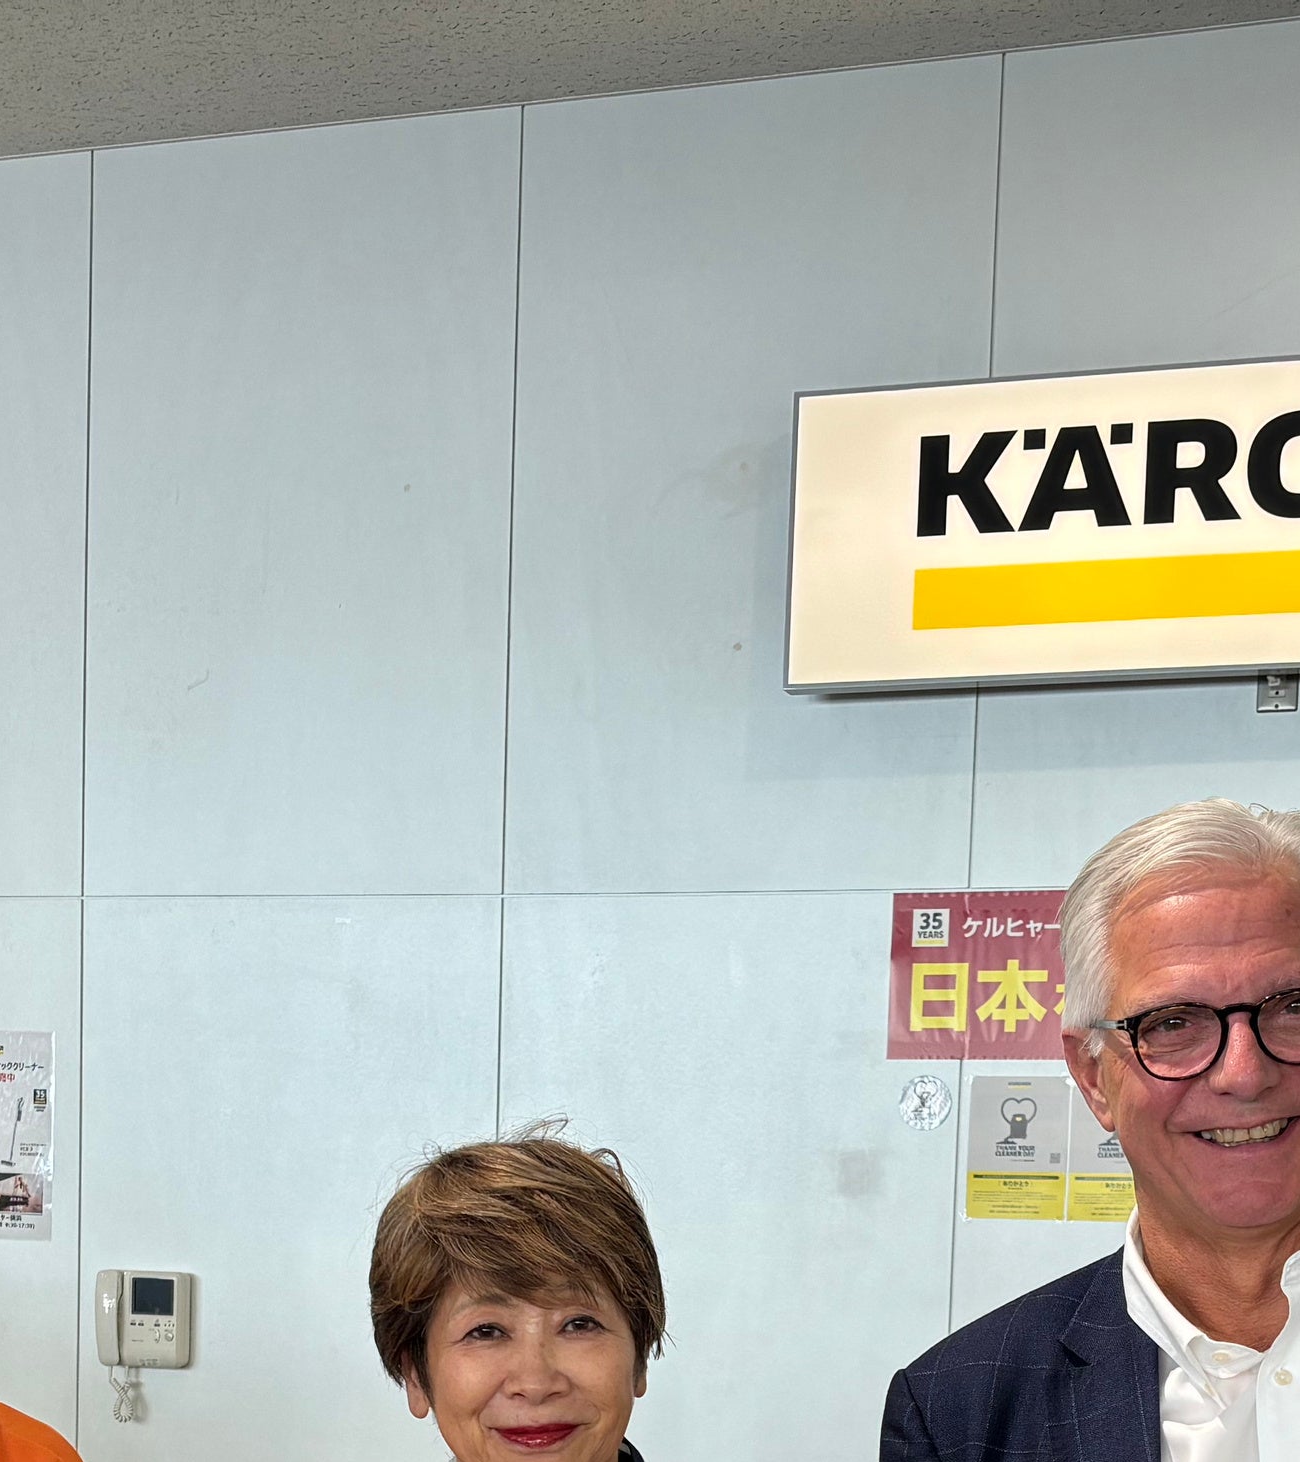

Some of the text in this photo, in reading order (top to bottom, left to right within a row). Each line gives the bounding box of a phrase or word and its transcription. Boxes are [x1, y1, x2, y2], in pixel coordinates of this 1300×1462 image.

[920, 912, 943, 930] 35
[917, 930, 944, 939] YEARS
[909, 959, 1065, 1033] 日本
